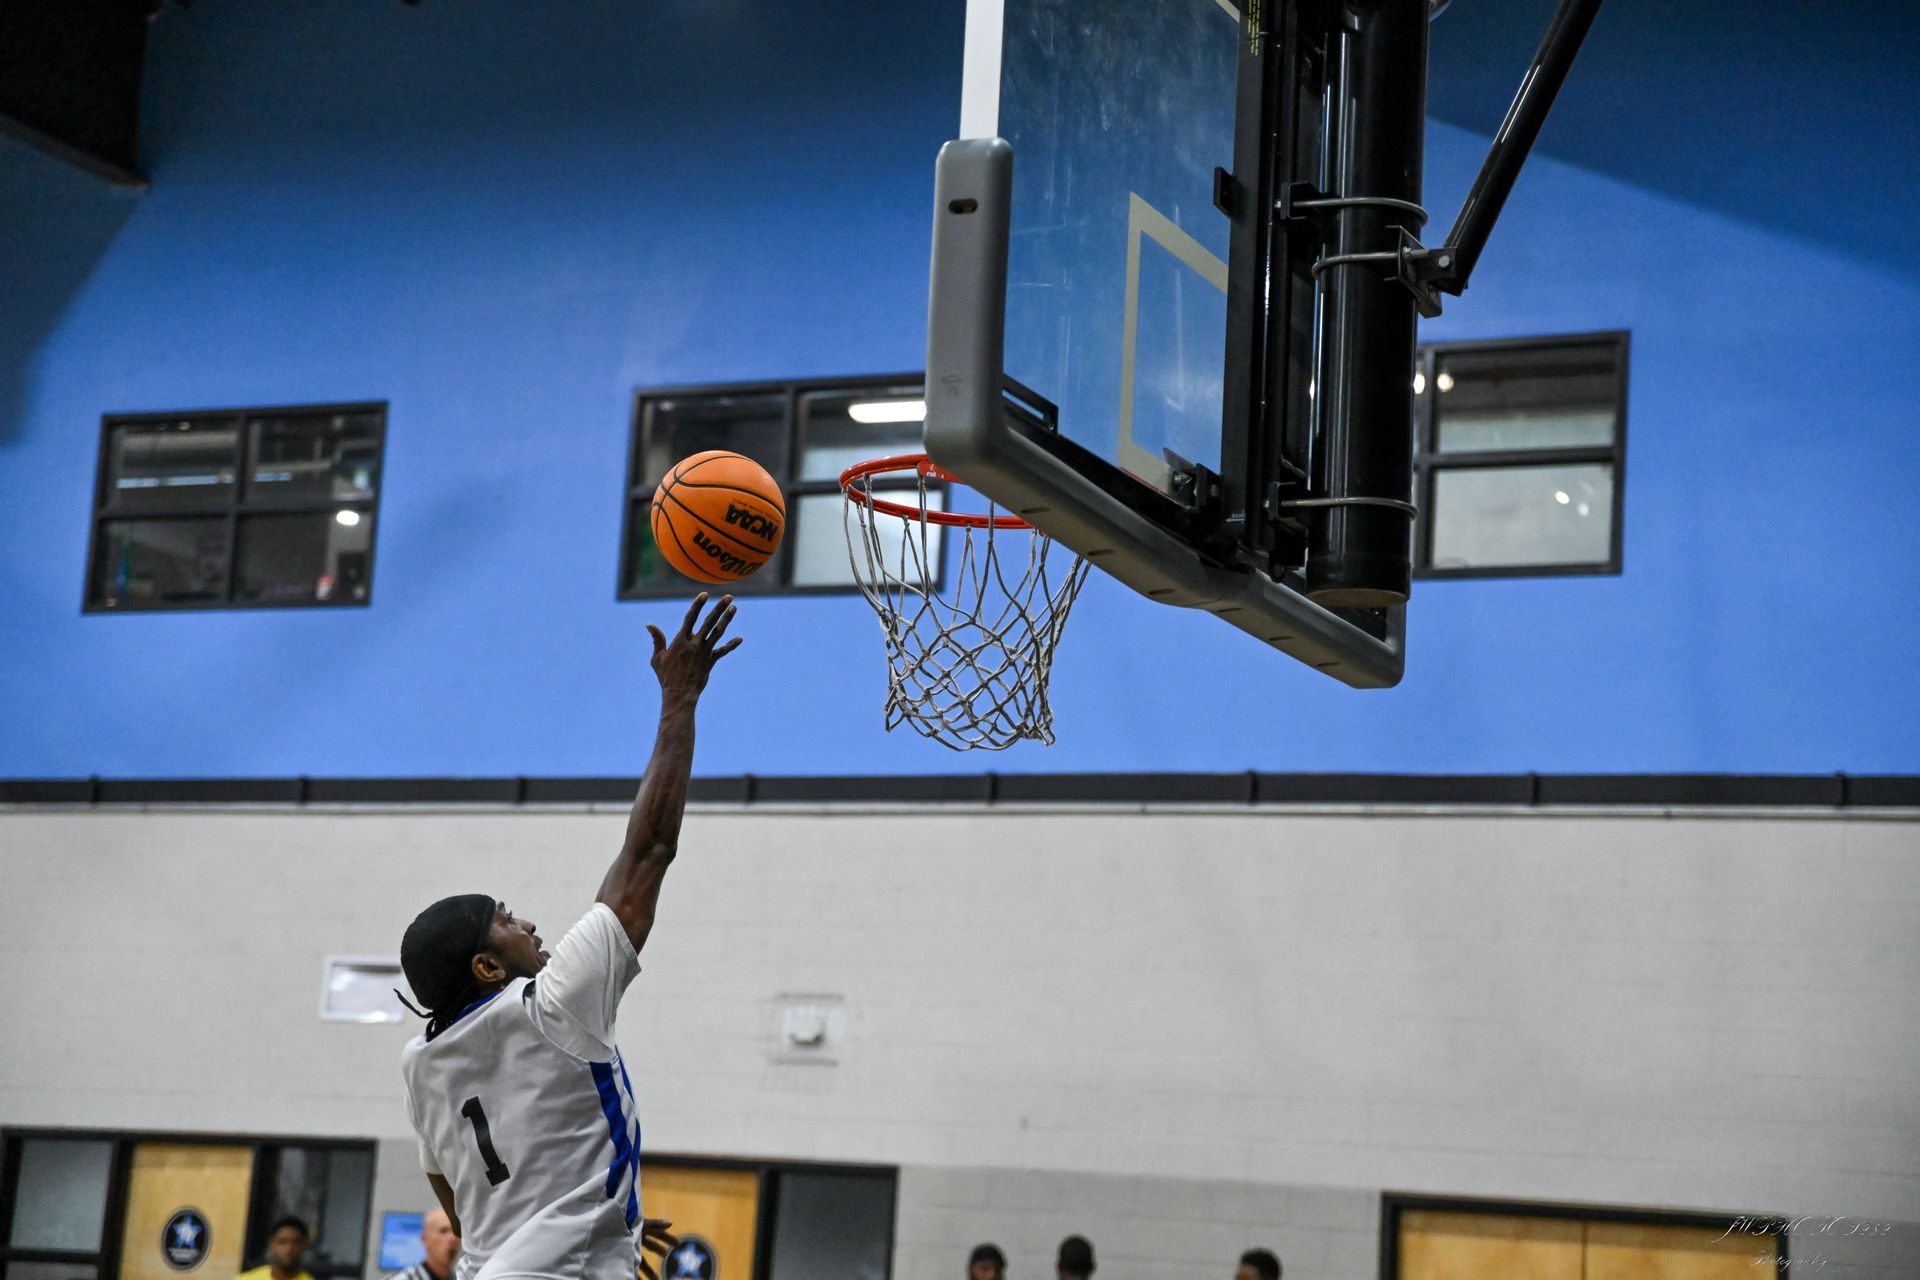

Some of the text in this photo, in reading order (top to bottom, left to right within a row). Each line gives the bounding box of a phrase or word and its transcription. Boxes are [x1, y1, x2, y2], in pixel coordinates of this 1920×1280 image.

[725, 504, 779, 542] NCAA
[693, 528, 765, 576] Wilson
[461, 1096, 511, 1187] 1
